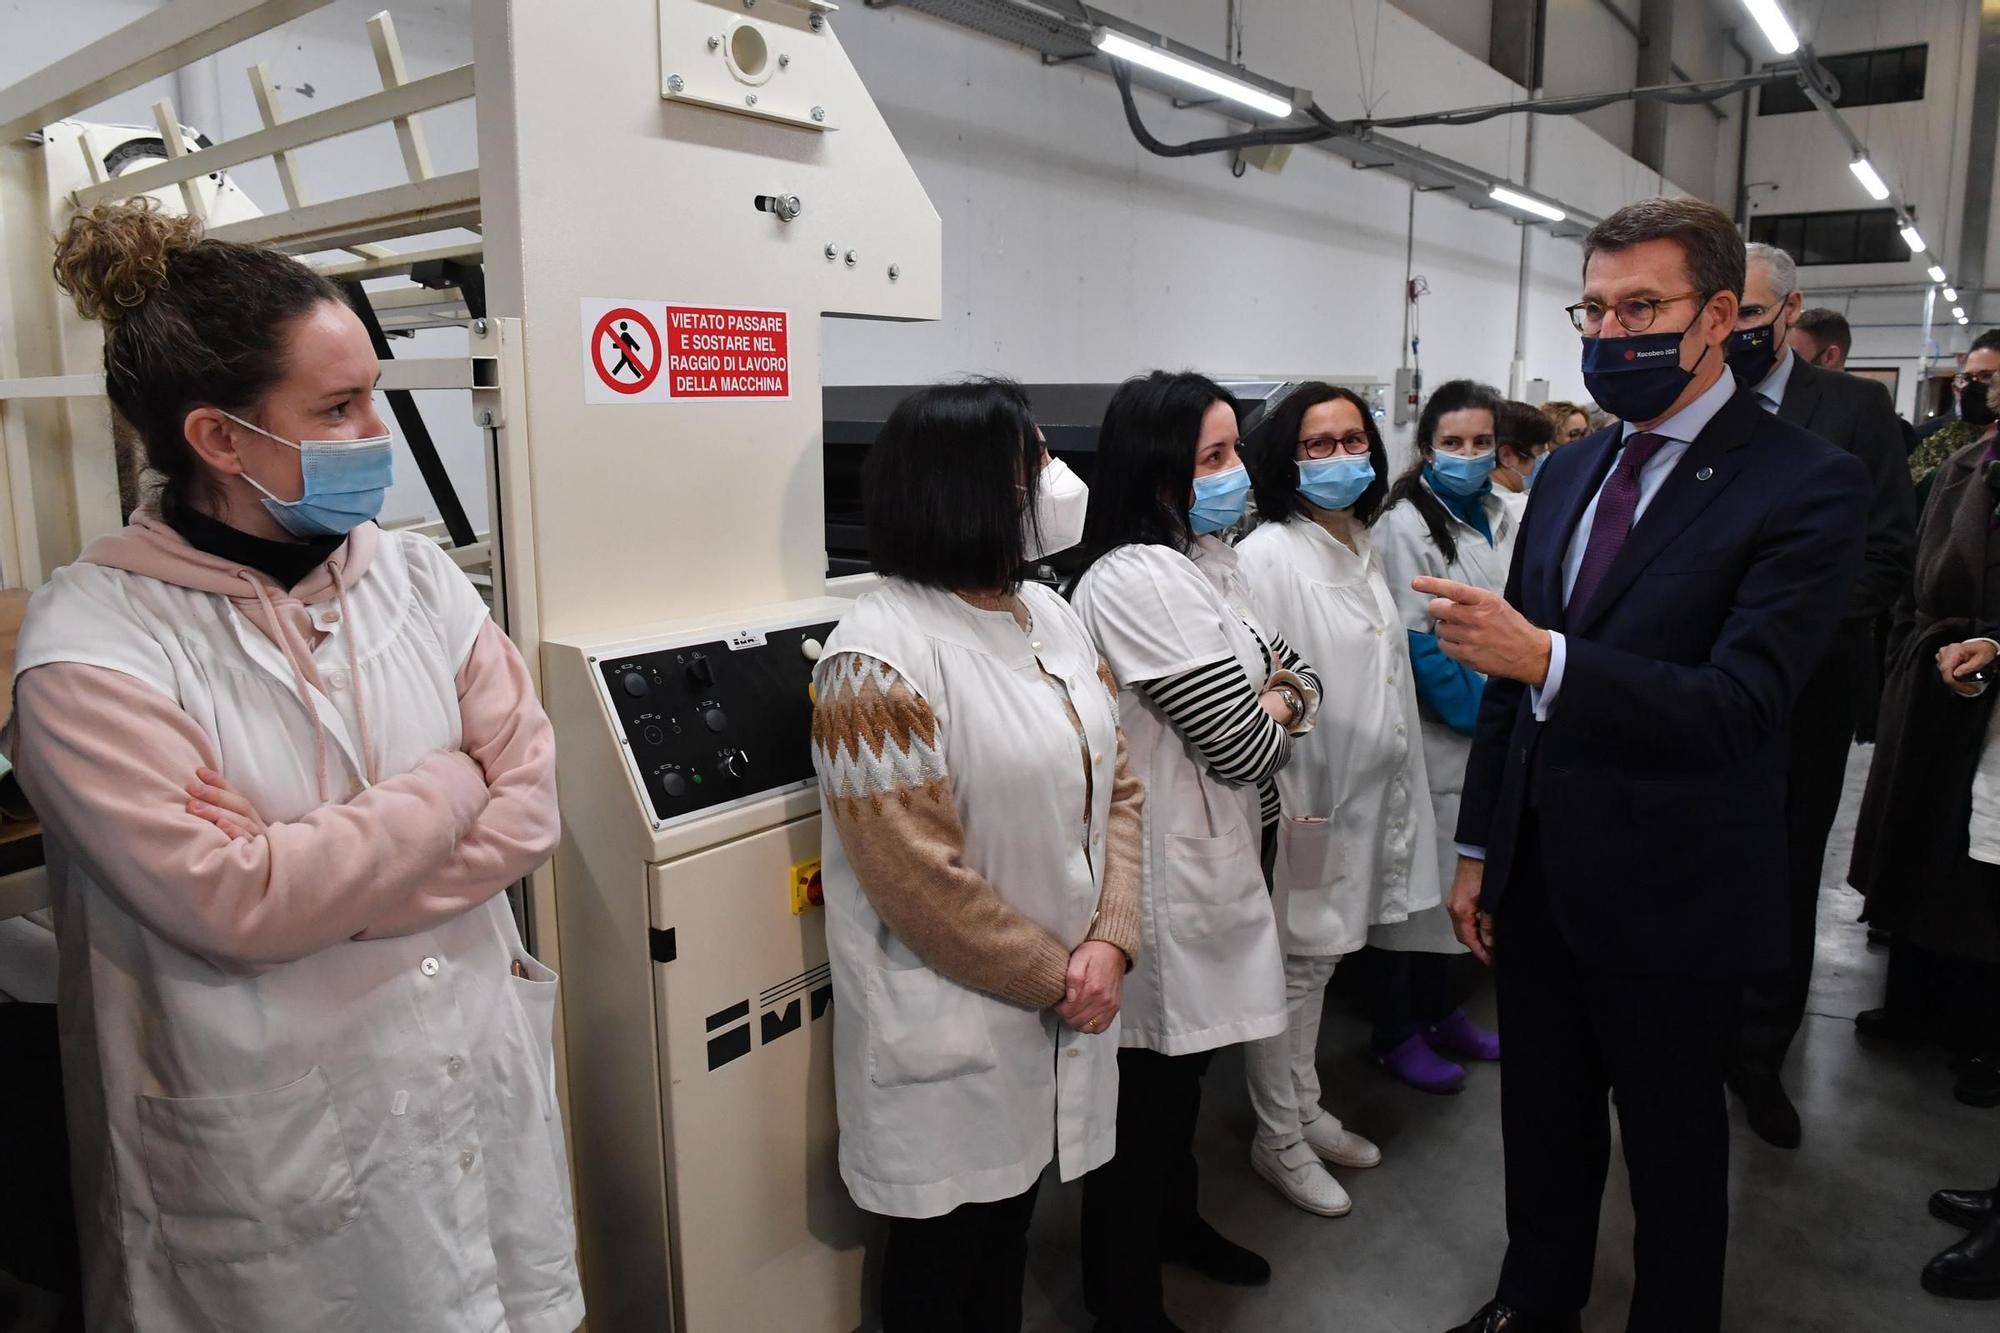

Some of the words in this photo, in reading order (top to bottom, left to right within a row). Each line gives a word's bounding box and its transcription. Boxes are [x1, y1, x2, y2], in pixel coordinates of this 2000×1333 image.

[671, 313, 725, 330] VIETATO
[728, 315, 783, 333] PASSARE
[681, 334, 690, 350] E
[692, 334, 750, 351] SOSTARE
[753, 337, 776, 352] NEL
[670, 355, 720, 371] RAGGIO
[723, 356, 735, 371] DI
[738, 356, 786, 372] LAVORO
[676, 376, 718, 392] DELLA
[721, 376, 783, 392] MACCHINA
